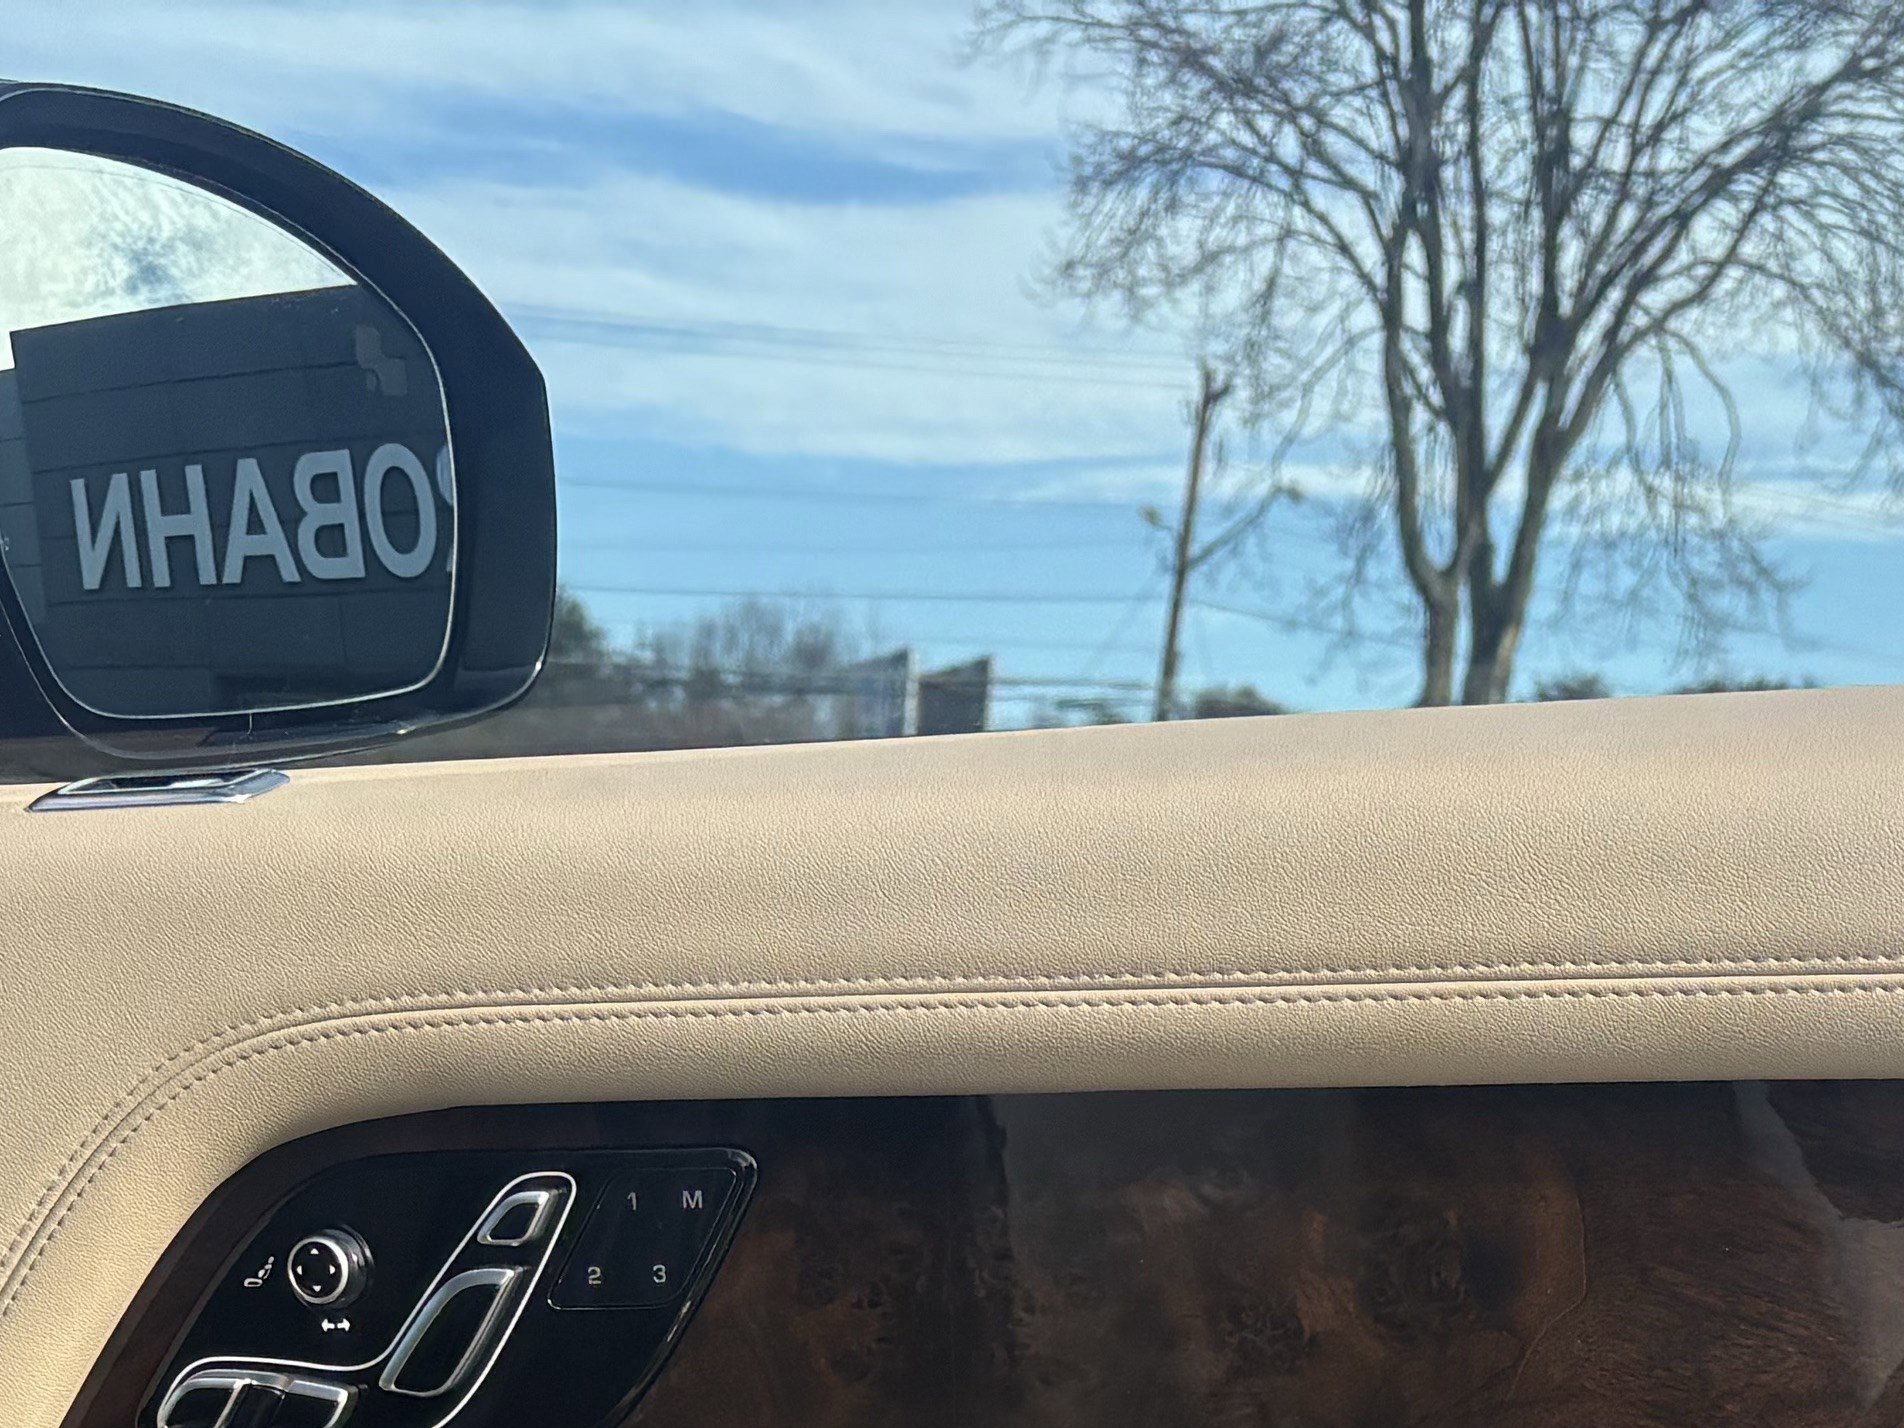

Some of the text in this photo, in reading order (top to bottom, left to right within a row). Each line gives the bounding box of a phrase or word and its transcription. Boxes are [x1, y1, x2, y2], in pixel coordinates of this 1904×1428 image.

[627, 1189, 703, 1211] 1 M
[587, 1264, 667, 1285] 2 3
